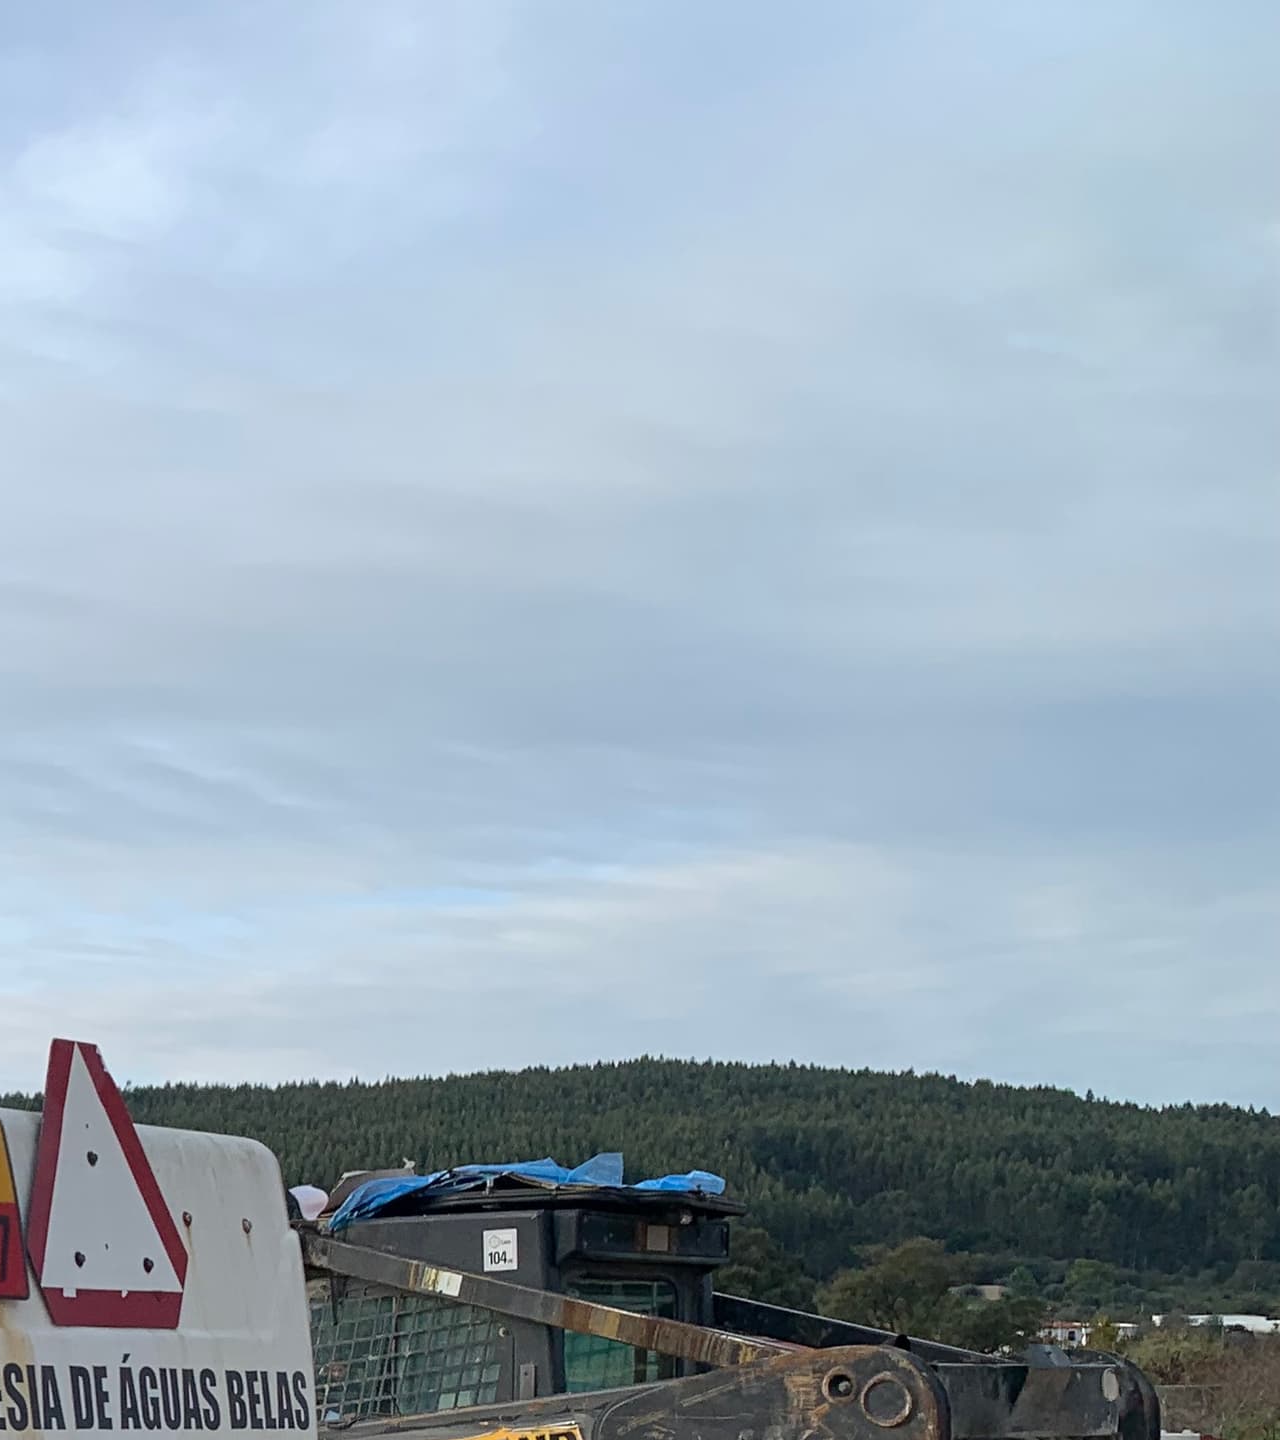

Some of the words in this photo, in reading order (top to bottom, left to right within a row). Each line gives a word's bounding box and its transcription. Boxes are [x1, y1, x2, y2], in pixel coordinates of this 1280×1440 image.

[488, 1250, 507, 1265] 104
[69, 1365, 113, 1431] DE
[119, 1353, 221, 1431] ÁGUAS
[224, 1370, 311, 1431] BELAS
